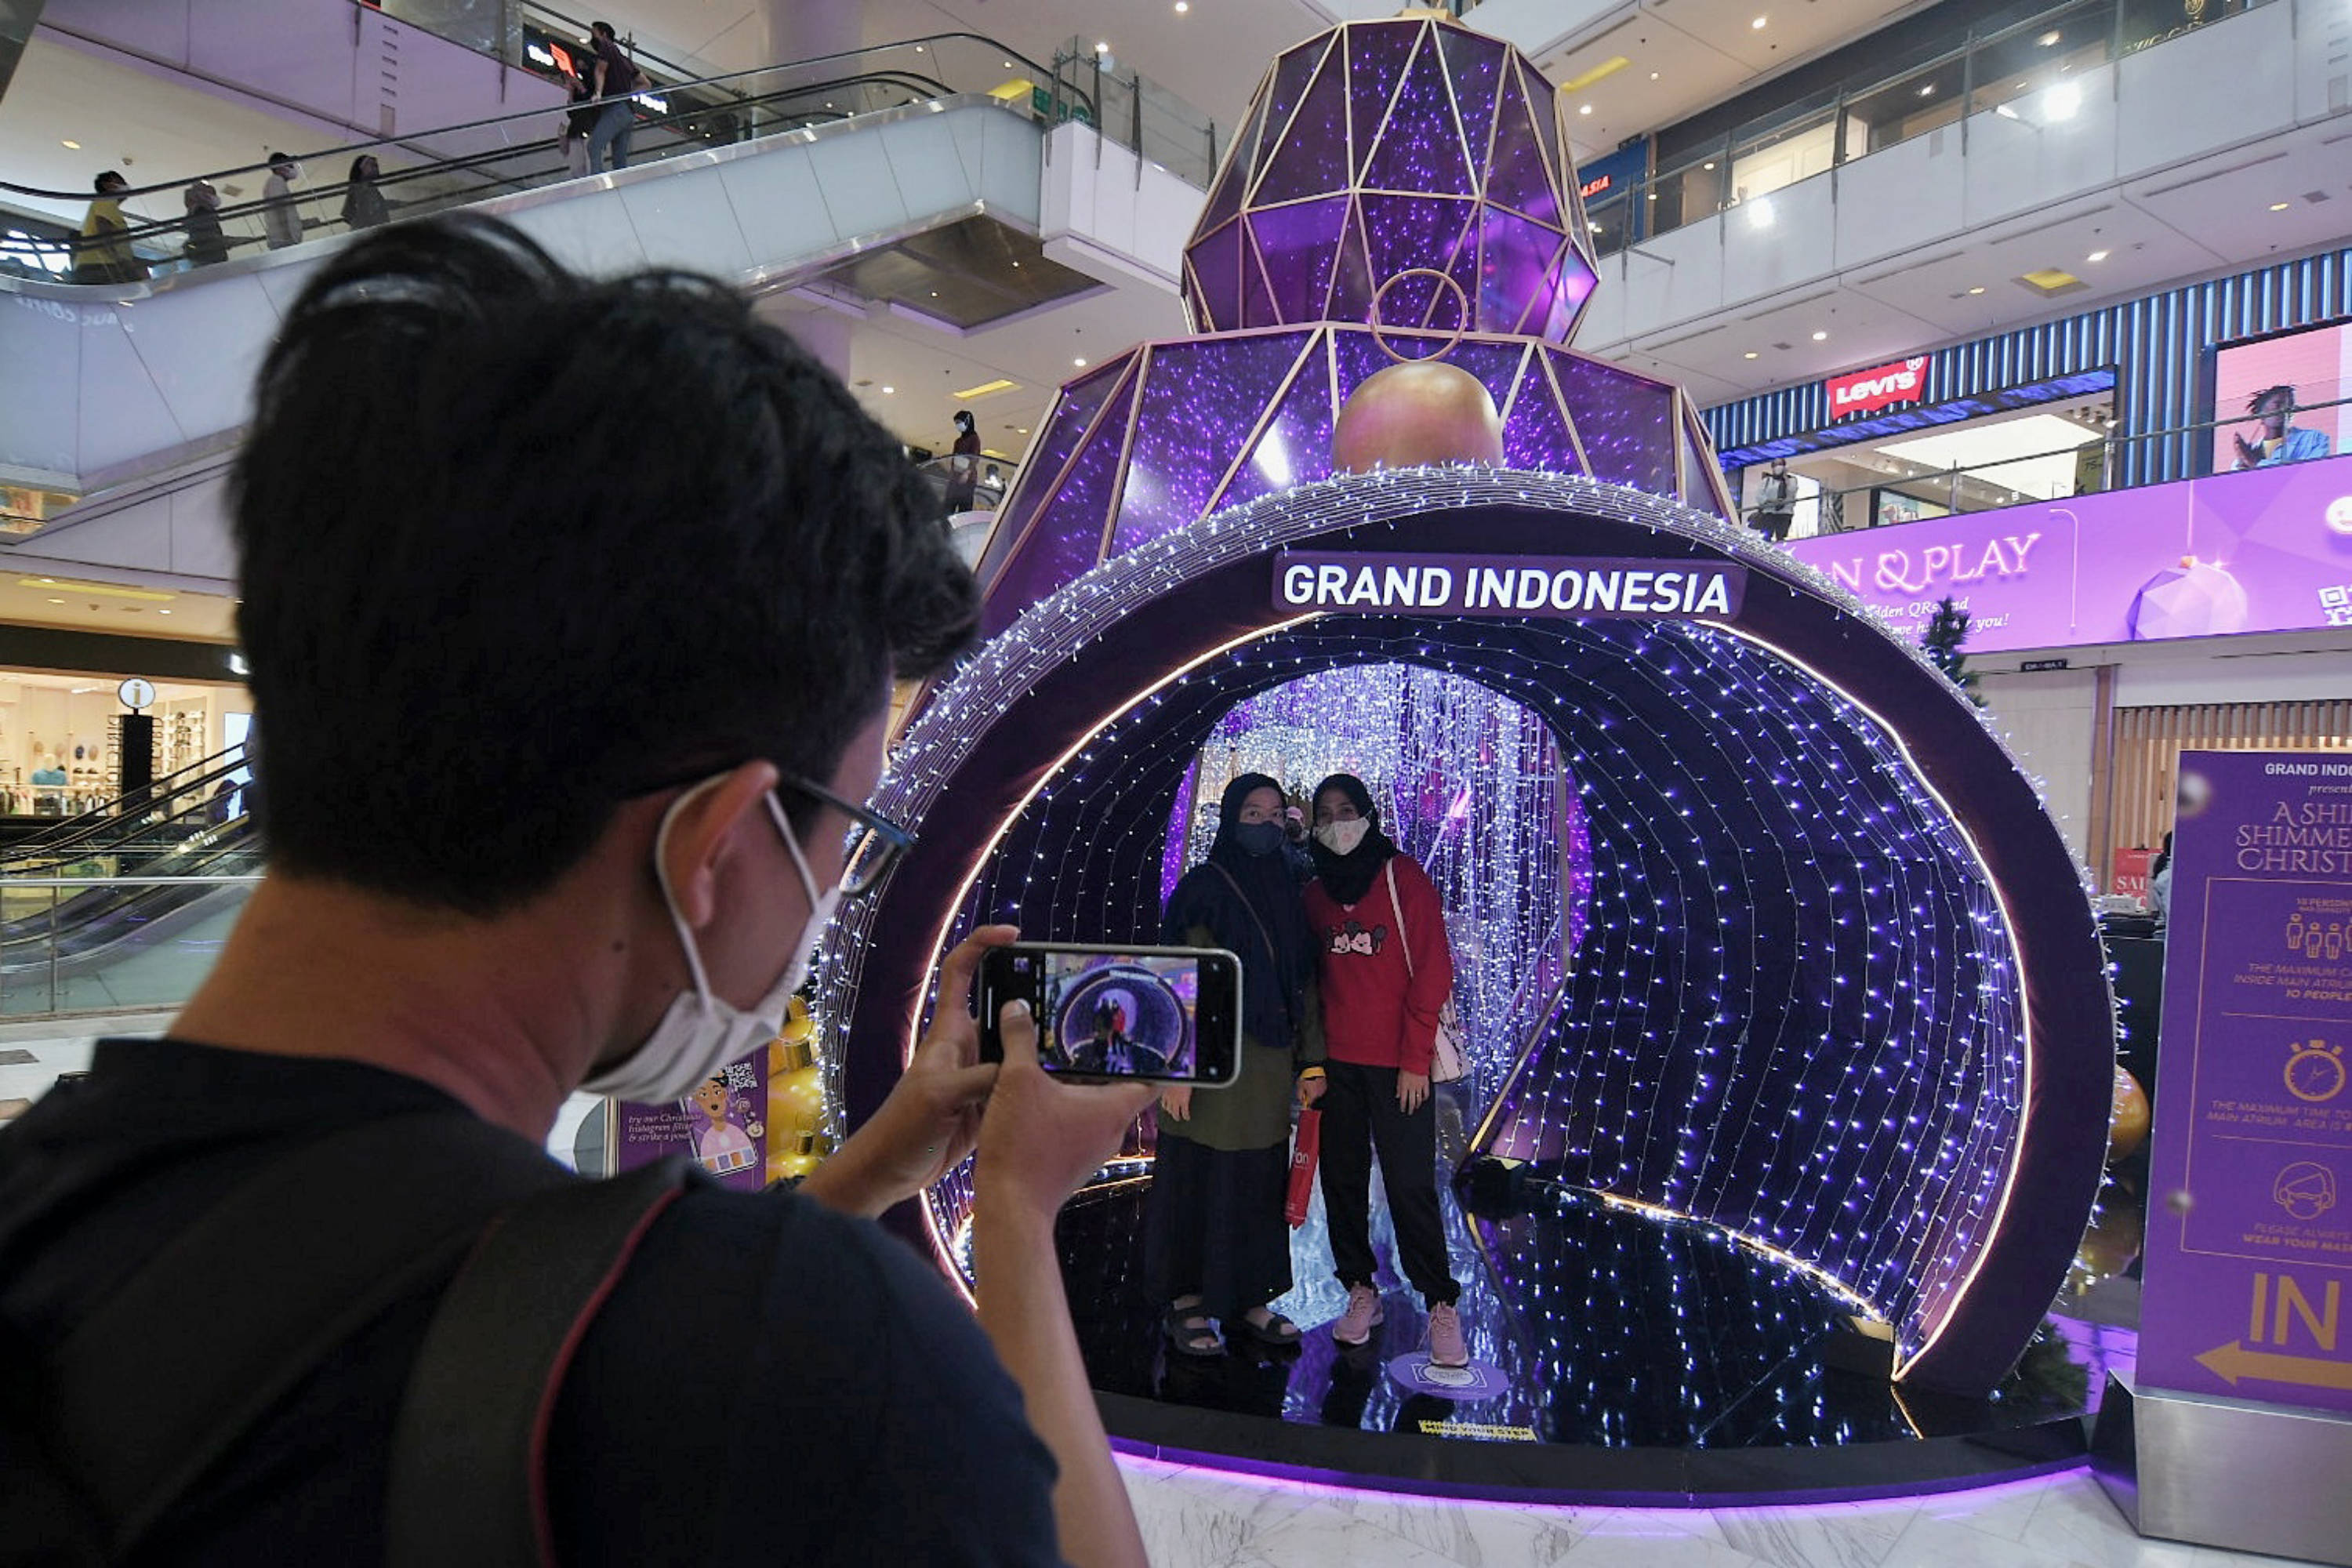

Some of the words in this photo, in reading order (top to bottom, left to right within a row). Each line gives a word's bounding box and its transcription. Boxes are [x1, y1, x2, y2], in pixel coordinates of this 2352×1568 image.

[1581, 175, 1611, 198] ASIA
[1875, 549, 1924, 592] &
[1923, 532, 2042, 584] PLAY
[1283, 564, 1453, 608] GRAND
[1464, 568, 1730, 615] INDONESIA
[1976, 613, 2009, 633] you!
[2264, 763, 2318, 775] GRAND
[2273, 800, 2299, 828] A
[2300, 803, 2352, 825] SHI
[2236, 825, 2352, 848] SHIMME
[2237, 848, 2352, 873] CHRIST
[2249, 1272, 2340, 1352] IN
